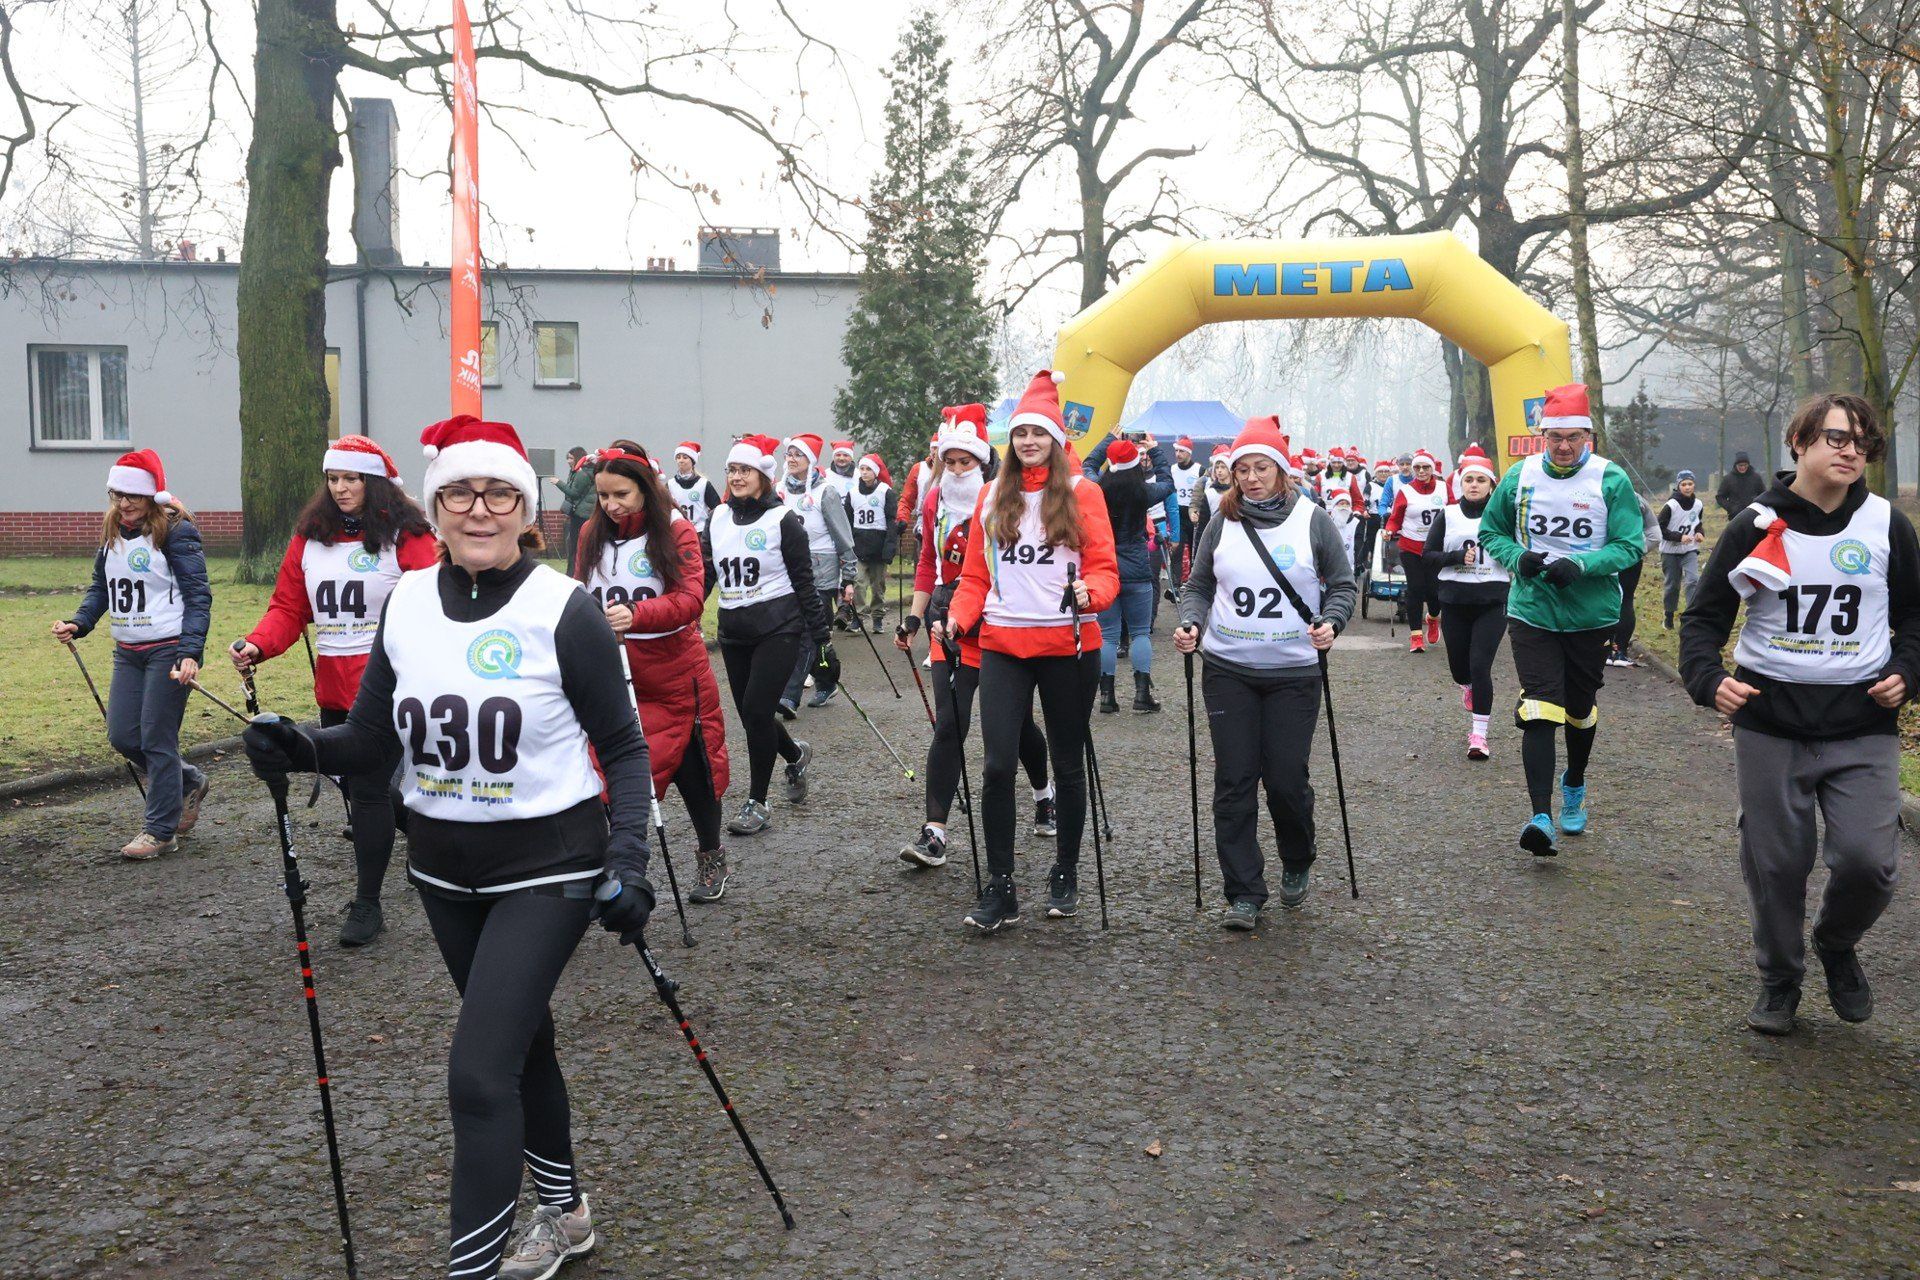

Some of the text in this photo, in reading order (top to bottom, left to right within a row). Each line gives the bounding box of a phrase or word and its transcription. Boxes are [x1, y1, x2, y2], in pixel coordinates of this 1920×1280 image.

[1214, 258, 1414, 296] META
[858, 509, 875, 525] 38
[1421, 509, 1441, 526] 67
[1529, 514, 1593, 539] 326
[1001, 544, 1055, 565] 492
[719, 557, 760, 588] 113
[109, 577, 146, 613] 131
[316, 580, 367, 619] 44
[1233, 586, 1283, 619] 92
[1778, 584, 1862, 636] 173
[397, 693, 523, 775] 230
